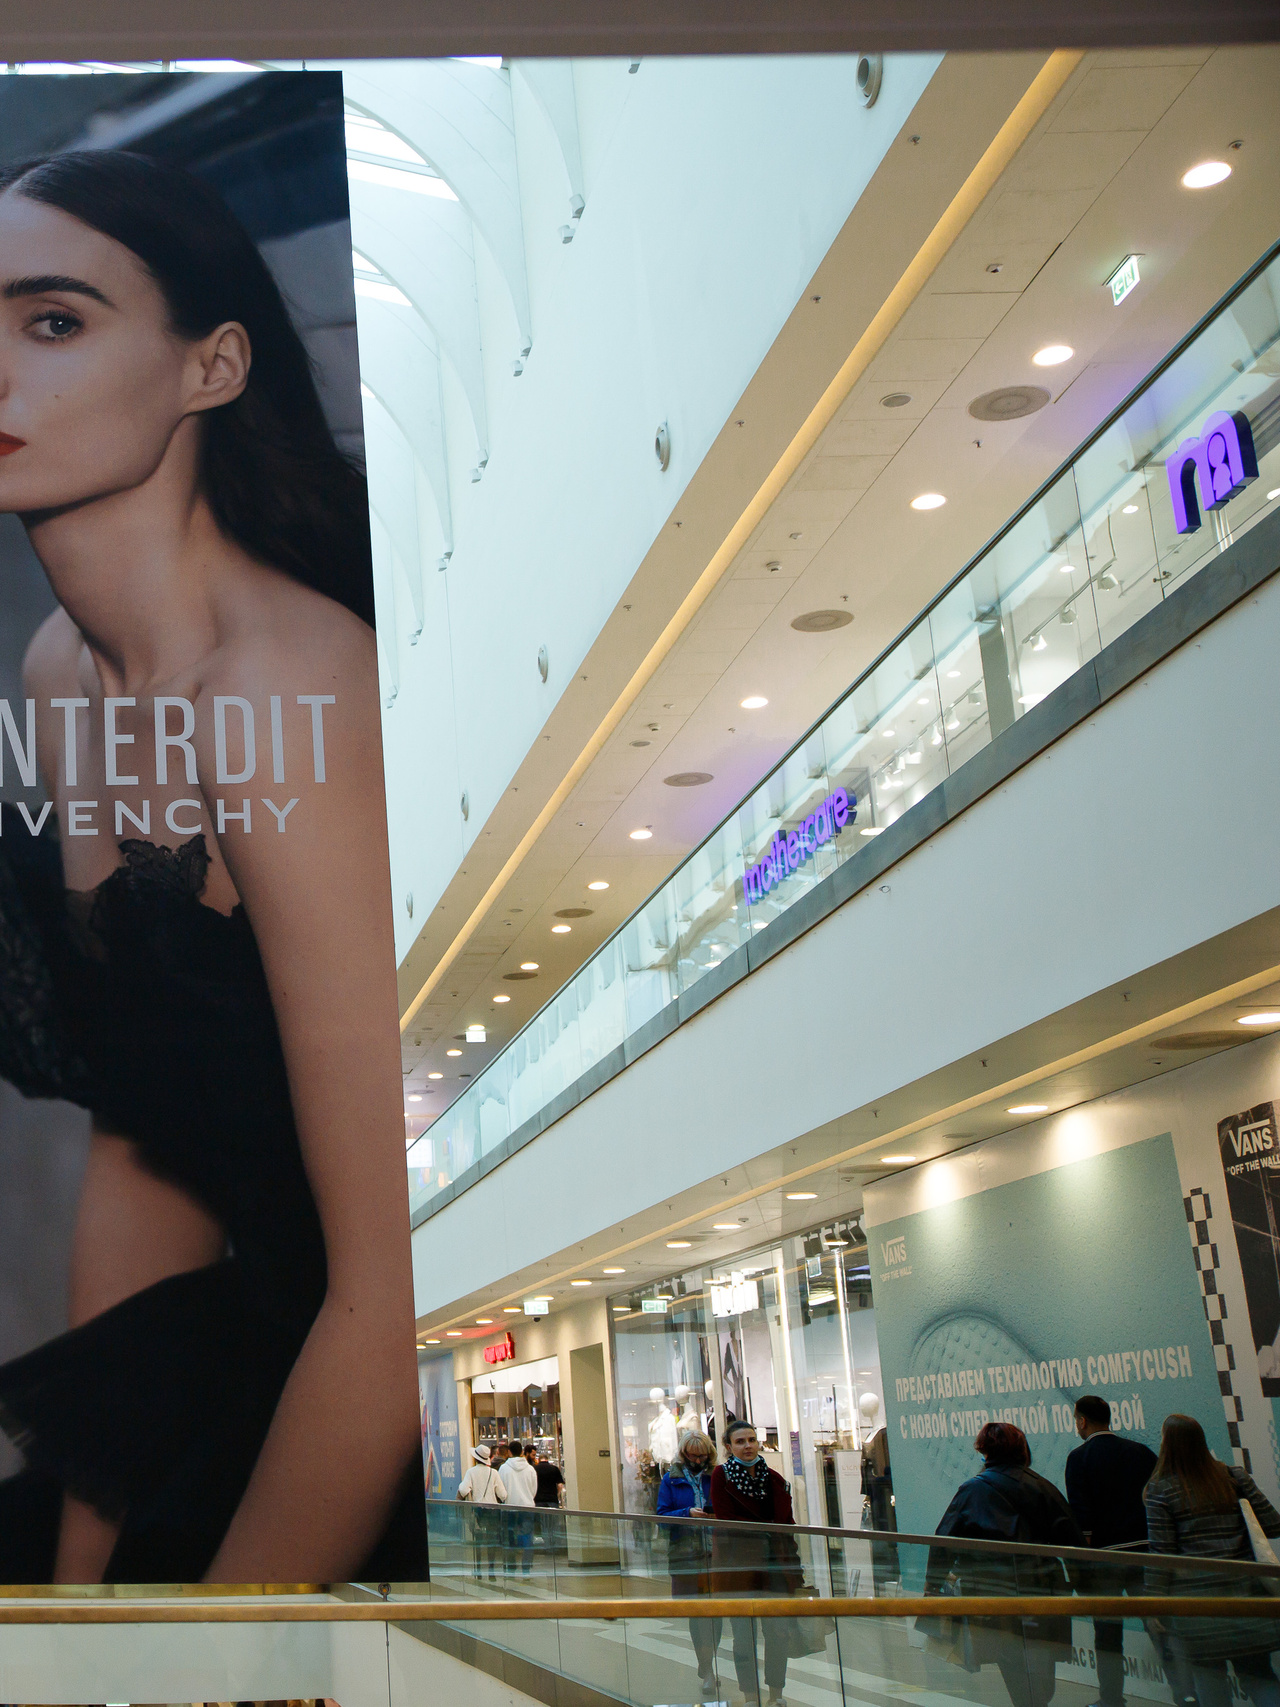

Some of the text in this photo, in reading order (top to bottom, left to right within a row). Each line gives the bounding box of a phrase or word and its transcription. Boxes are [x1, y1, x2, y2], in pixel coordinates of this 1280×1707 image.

[742, 786, 850, 907] mothercare
[1228, 1119, 1273, 1158] VANS
[1245, 1159, 1260, 1172] THE
[880, 1235, 908, 1267] VANS
[895, 1345, 1193, 1405] ПРЕДСТАВЛЯЕМ ТЕХНОЛОГИЮ COMFYCUSH
[900, 1415, 908, 1440] С
[909, 1407, 949, 1439] НОВОЙ
[1051, 1393, 1146, 1438] ПОВОЙ
